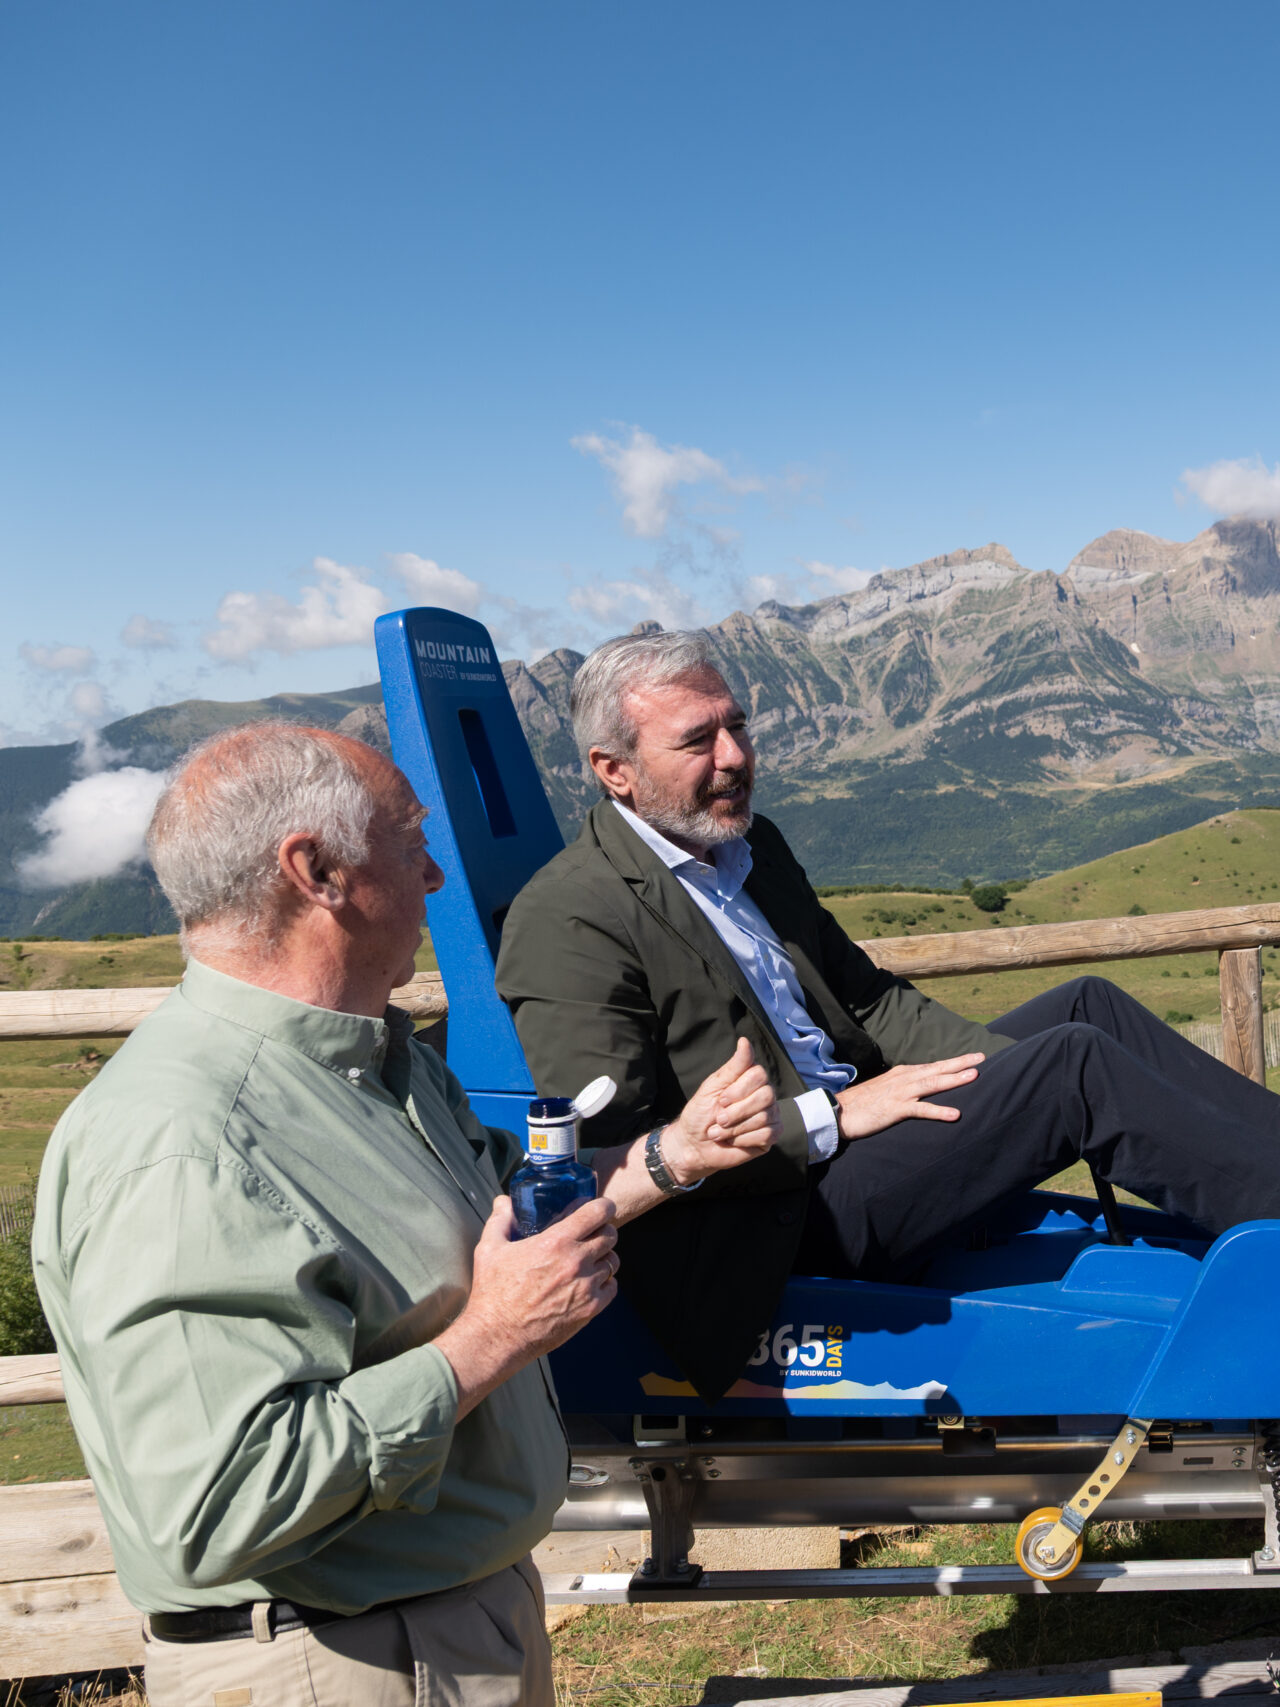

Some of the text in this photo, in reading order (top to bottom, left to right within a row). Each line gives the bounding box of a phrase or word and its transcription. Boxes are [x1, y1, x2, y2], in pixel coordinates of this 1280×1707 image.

[414, 639, 491, 664] MOUNTAIN
[420, 661, 457, 680] COASTER
[746, 1323, 825, 1367] 365
[826, 1325, 843, 1367] DAYS
